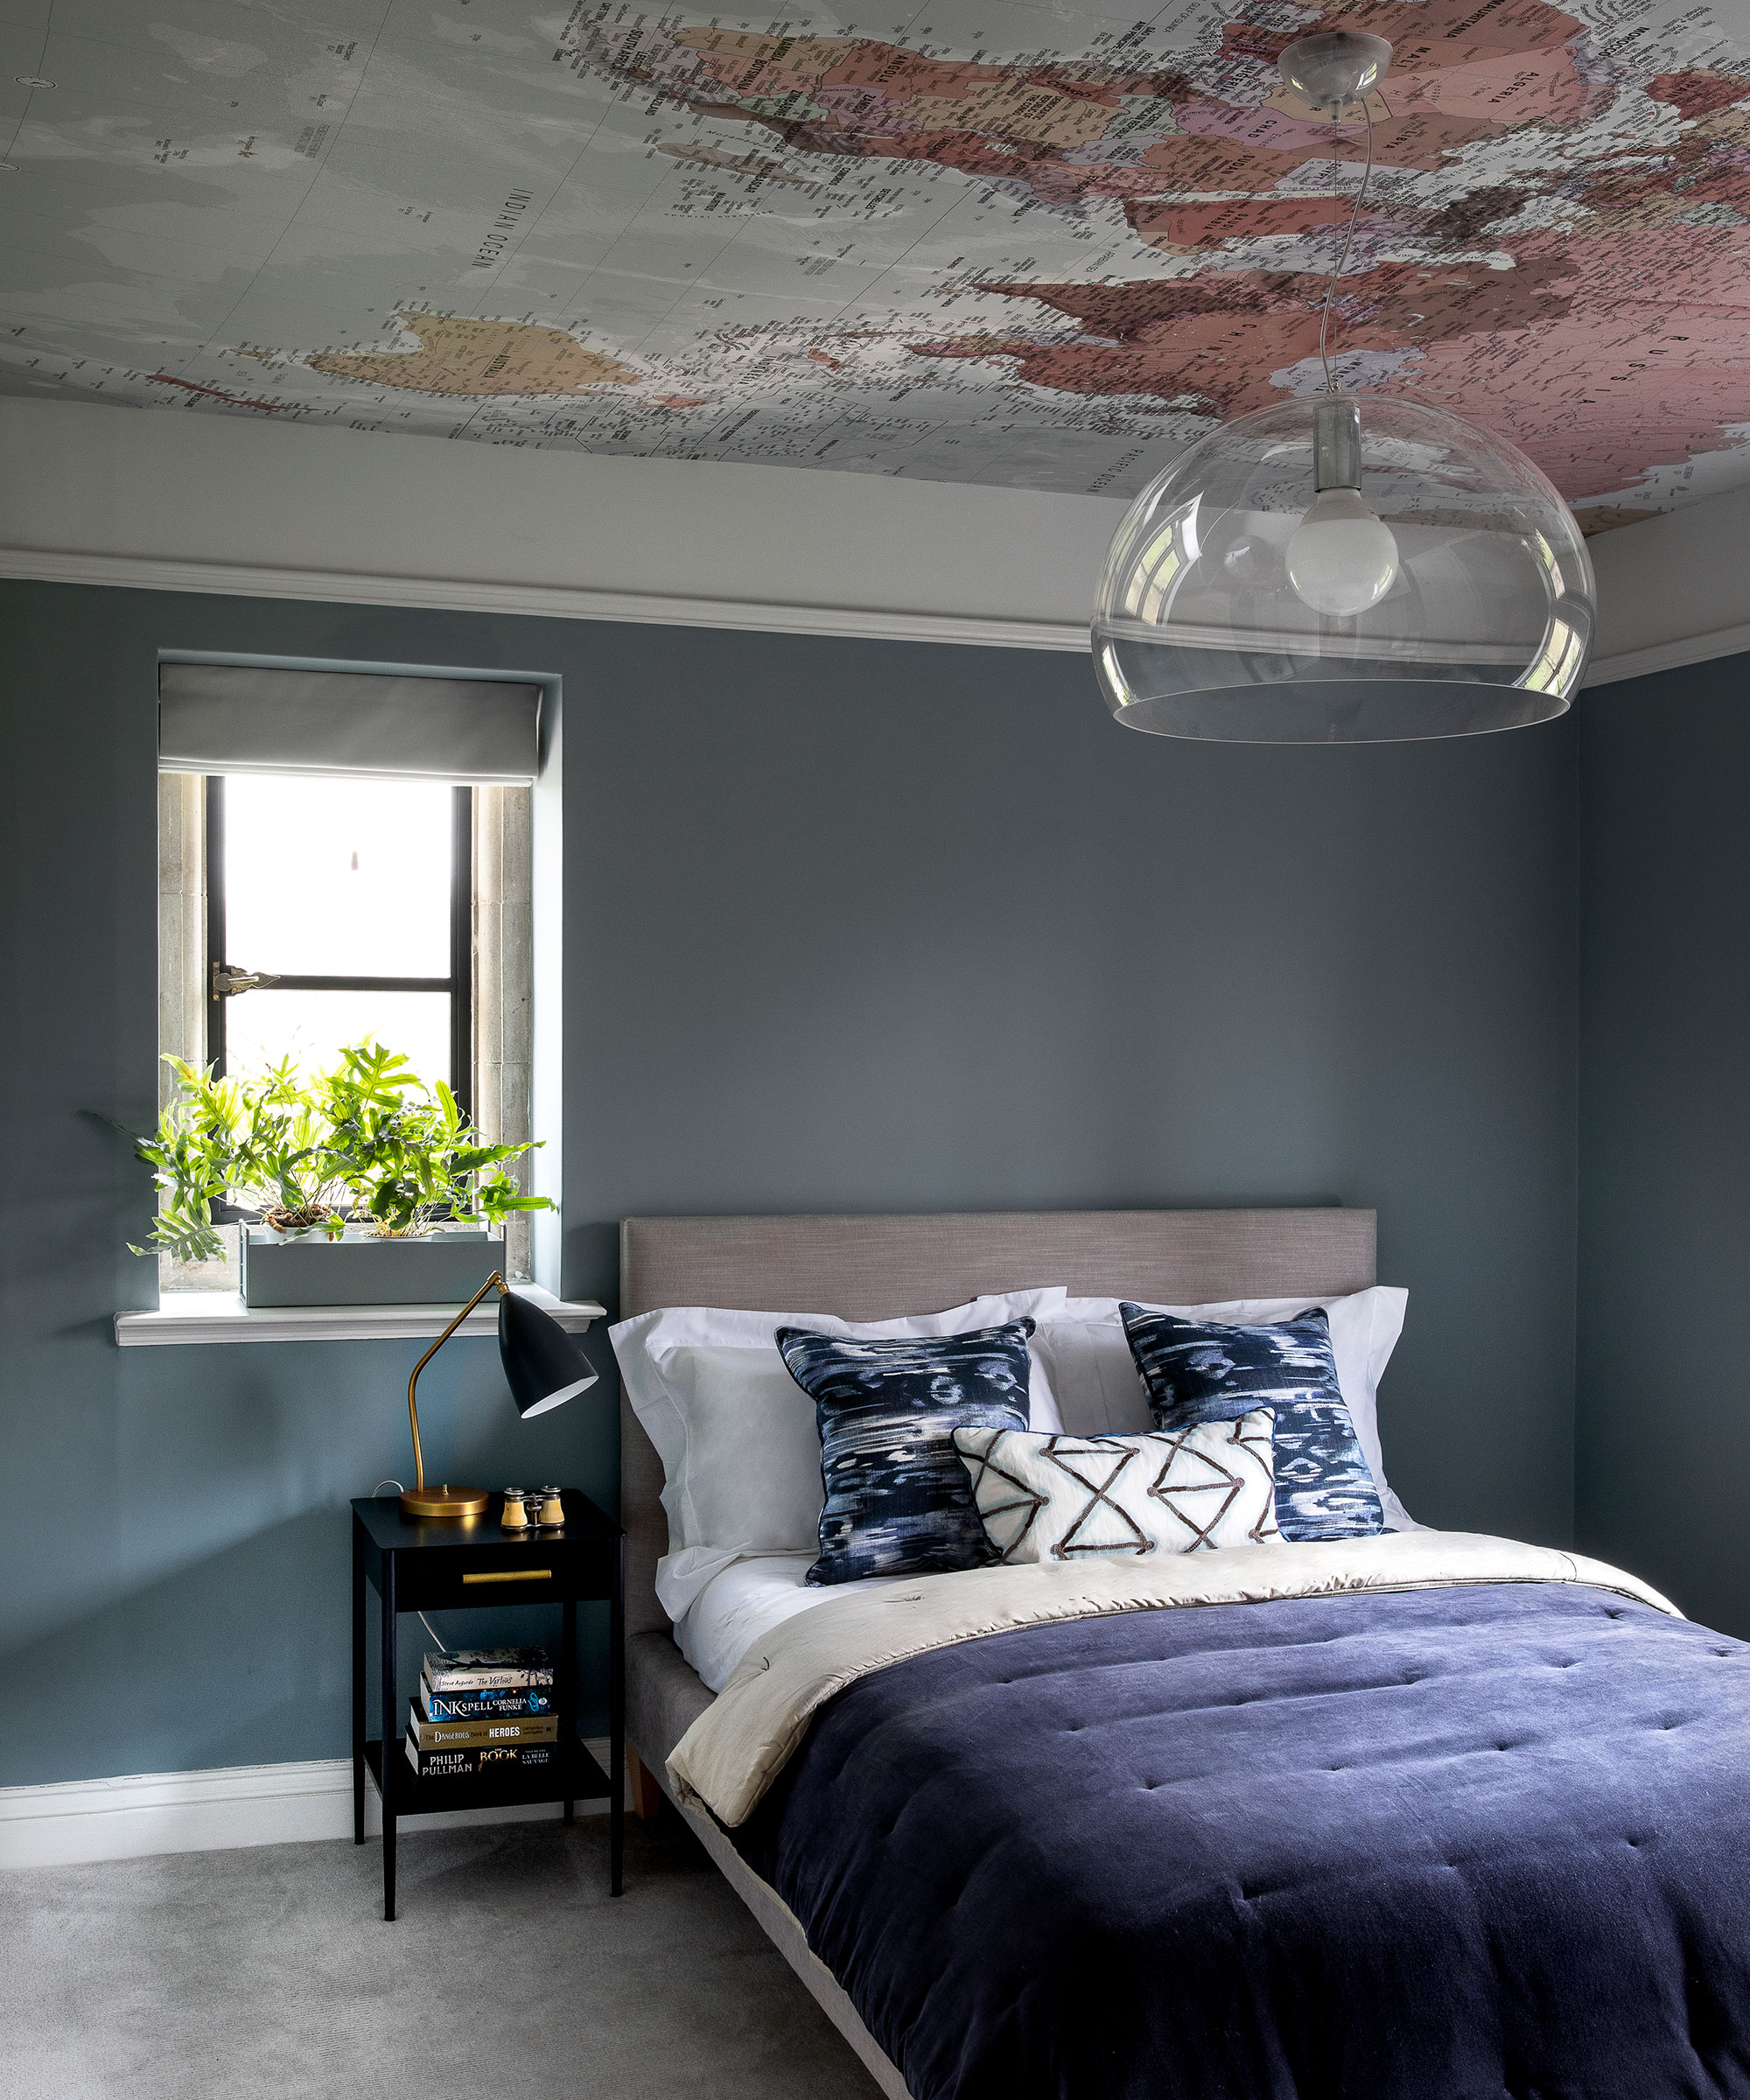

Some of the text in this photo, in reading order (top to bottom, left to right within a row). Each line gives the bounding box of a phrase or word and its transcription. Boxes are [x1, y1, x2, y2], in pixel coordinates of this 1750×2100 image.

[1240, 6, 1270, 26] D'IVOIRE
[1268, 14, 1292, 27] CÔTE
[1441, 0, 1505, 38] MAURITANIA
[608, 29, 643, 71] SOUTH AFRICA
[766, 36, 797, 61] NAMIBIA
[1595, 26, 1651, 56] MOROCCO
[1120, 52, 1154, 76] EQUATORIAL
[1394, 46, 1432, 67] MALI
[735, 60, 767, 90] BOTSWANA
[874, 54, 909, 83] ANGOLA
[1074, 66, 1098, 82] GABON
[1110, 60, 1134, 75] GUINEA
[1046, 80, 1093, 98] CONGO
[1215, 65, 1258, 93] NIGERIA
[1486, 72, 1542, 103] ALGERIA
[1663, 80, 1703, 98] SPAIN
[642, 90, 669, 116] SWAZILAND
[770, 89, 804, 117] ZIMBABWE
[850, 94, 875, 114] ZAMBIA
[1011, 102, 1032, 116] CONGO
[1027, 94, 1052, 112] REPUBLIC
[1031, 95, 1064, 120] DEMOCRATIC
[1110, 102, 1163, 140] AFRICAN REPUBLIC
[1133, 113, 1162, 131] CENTRAL
[1245, 119, 1278, 138] CHAD
[922, 135, 954, 158] TANZANIA
[1381, 130, 1418, 149] LIBYA
[1103, 145, 1126, 159] SUDAN
[1116, 147, 1138, 160] SOUTH
[1004, 160, 1029, 176] KENYA
[1219, 154, 1256, 174] SUDAN
[1311, 163, 1343, 179] EGYPT
[743, 161, 778, 193] MADAGASCAR
[827, 166, 851, 186] COMOROS
[864, 187, 892, 209] SEYCHELLES
[1010, 199, 1040, 217] SOMALIA
[469, 187, 535, 269] INDIAN OCEAN
[1200, 209, 1236, 230] ARABIA
[1217, 213, 1250, 230] SAUDI
[480, 354, 512, 380] AUSTRALIA
[1574, 335, 1690, 405] RUSSIA
[1082, 448, 1145, 494] PACIFIC OCEAN
[477, 1676, 513, 1687] The Various
[432, 1699, 493, 1717] INKSPELL
[434, 1731, 470, 1743] DANGEROUS
[489, 1726, 521, 1738] HEROES
[430, 1754, 465, 1766] PHILIP
[480, 1748, 518, 1761] BOOK
[422, 1763, 472, 1776] PULLMAN
